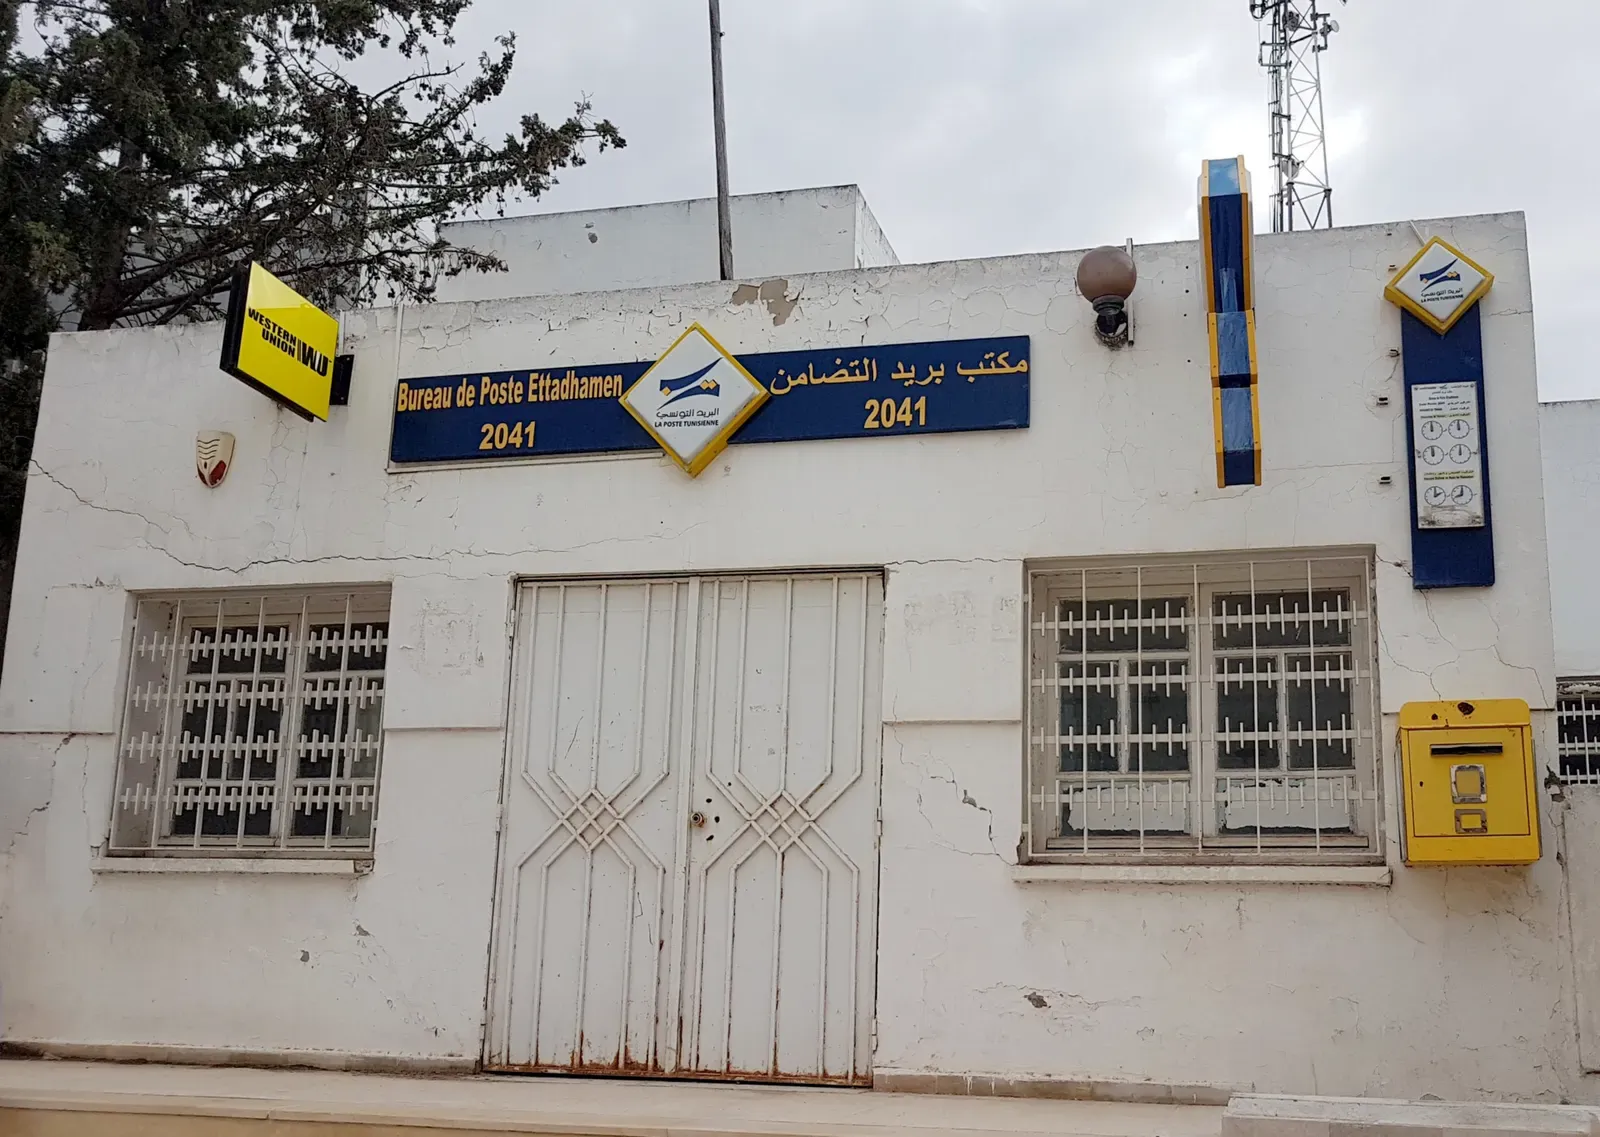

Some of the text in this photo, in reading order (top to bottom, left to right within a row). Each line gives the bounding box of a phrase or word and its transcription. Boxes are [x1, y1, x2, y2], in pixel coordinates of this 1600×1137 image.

[248, 307, 297, 347] WESTERN
[262, 328, 296, 358] UNION
[302, 341, 329, 377] WU
[769, 351, 1029, 395] مكتب بريد التضامن
[397, 370, 623, 412] Bureau de Poste Ettadhamen
[656, 408, 720, 419] البريد التونسي
[863, 396, 928, 429] 2041
[479, 421, 536, 450] 2041
